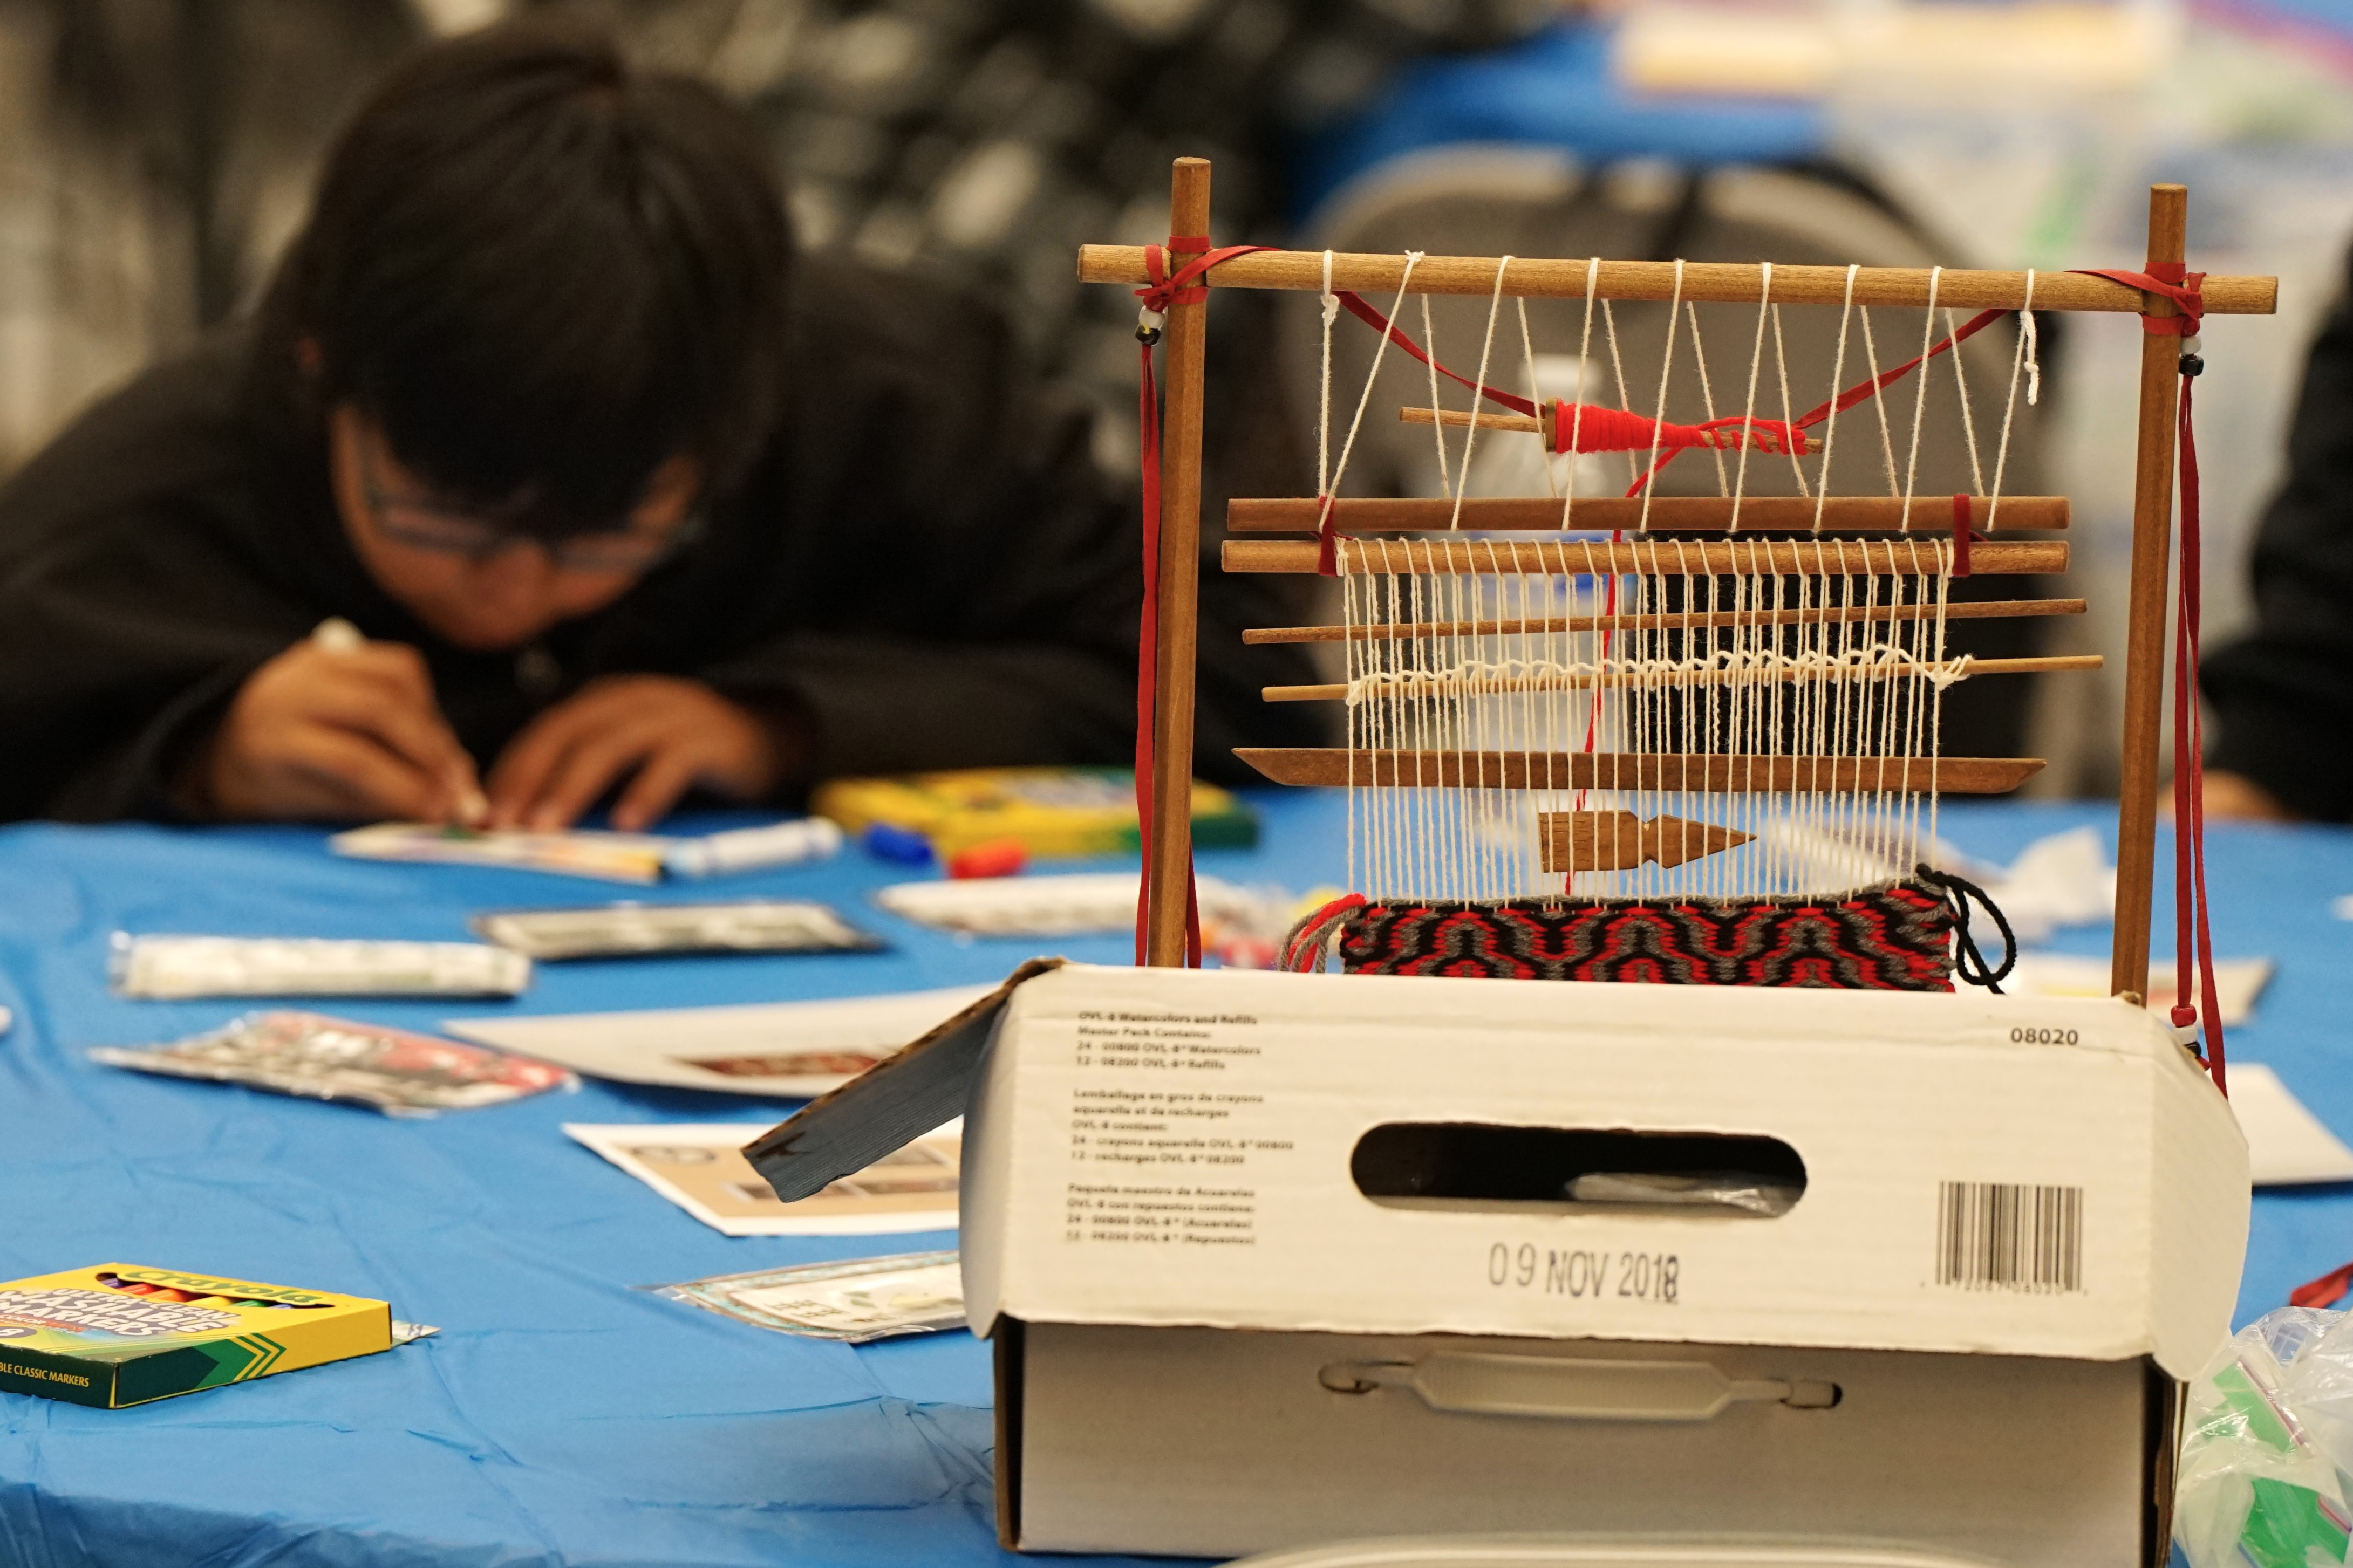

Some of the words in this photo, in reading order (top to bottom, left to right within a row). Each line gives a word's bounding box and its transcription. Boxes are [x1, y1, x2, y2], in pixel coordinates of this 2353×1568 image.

[1119, 1012, 1190, 1023] Watercolors
[1194, 1015, 1216, 1023] and
[1220, 1015, 1257, 1024] Refills
[1077, 1027, 1118, 1035] Master
[1123, 1028, 1150, 1036] Pack
[2011, 1027, 2078, 1045] 08020
[1077, 1042, 1090, 1050] 24
[1189, 1044, 1260, 1055] Watercolors
[1188, 1059, 1225, 1069] Refills
[1167, 1093, 1193, 1103] gros
[1198, 1092, 1212, 1101] de
[1216, 1094, 1263, 1104] crayons
[1073, 1106, 1130, 1115] aquarelle
[1150, 1107, 1164, 1115] de
[1168, 1108, 1229, 1119] recharges
[1096, 1138, 1143, 1147] crayons
[1148, 1138, 1205, 1148] aquarelle
[1095, 1153, 1156, 1163] recharges
[1177, 1187, 1190, 1195] de
[1546, 1250, 1608, 1298] NOV
[1618, 1252, 1679, 1303] 2018
[125, 1271, 322, 1303] Crayola
[52, 1288, 241, 1319] ULTRA-CLEAN
[0, 1290, 229, 1333] WASHABLE
[0, 1301, 166, 1336] MARKERS
[14, 1365, 48, 1380] CLASSIC
[49, 1371, 90, 1387] MARKERS
